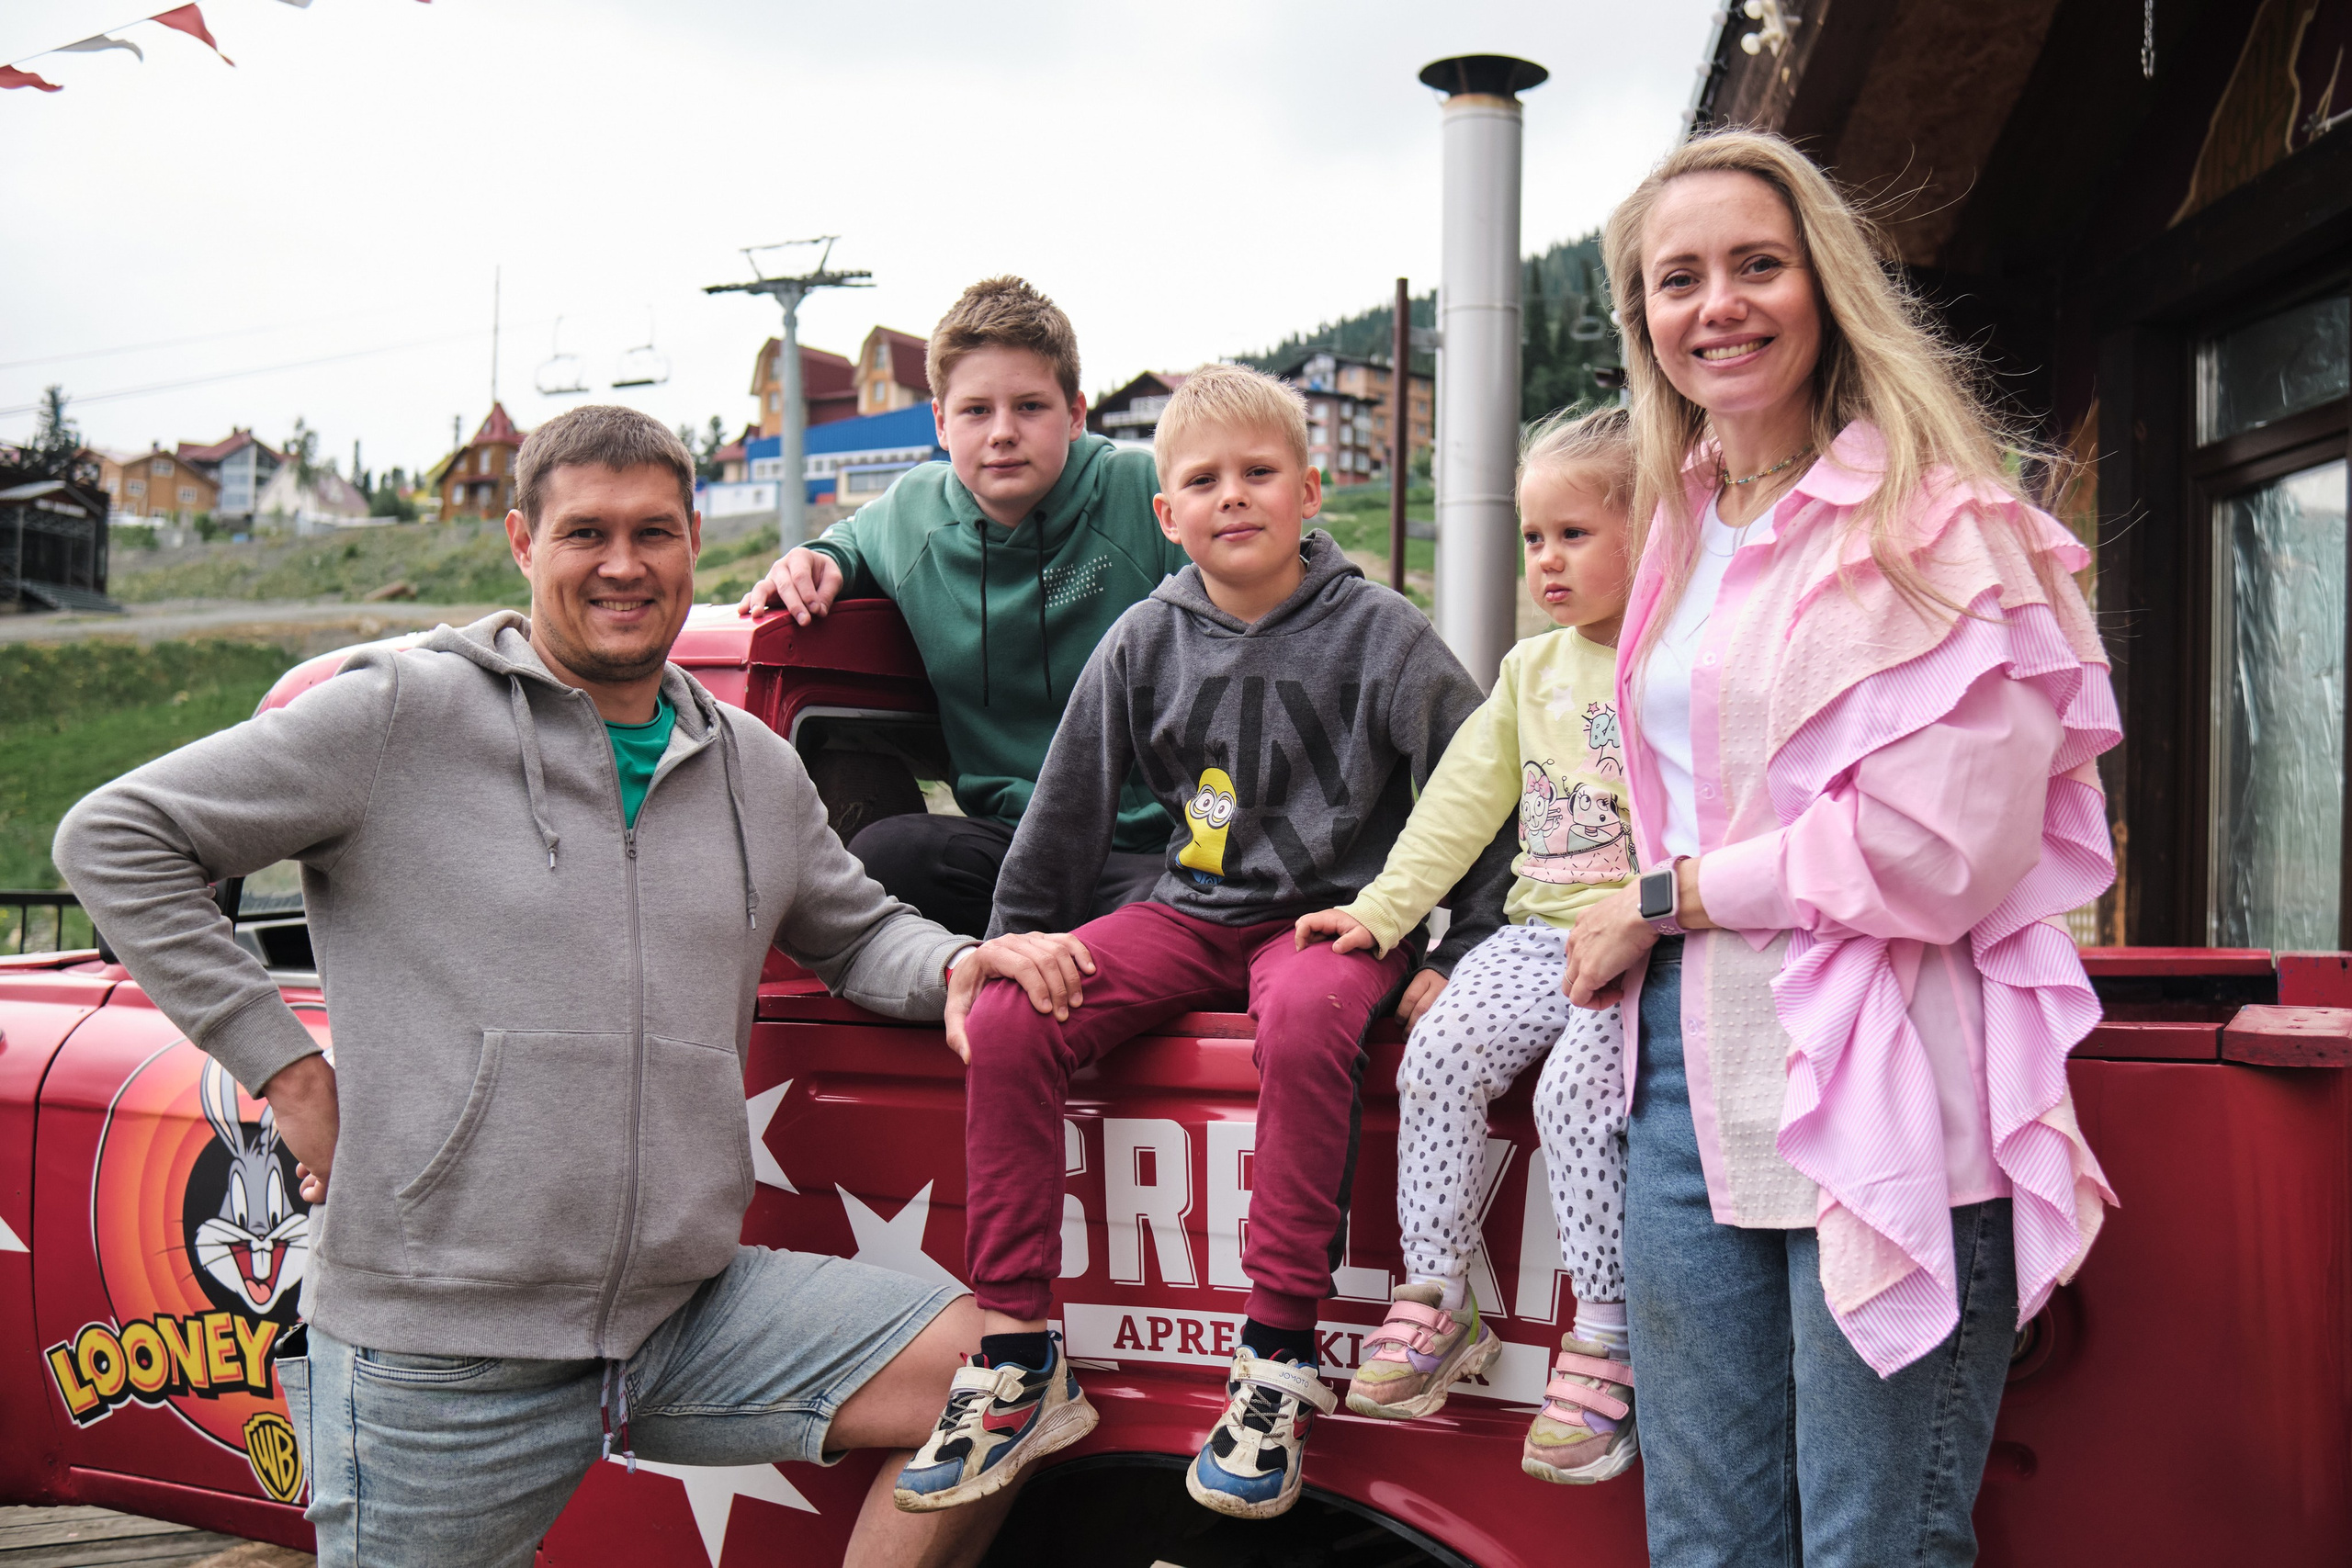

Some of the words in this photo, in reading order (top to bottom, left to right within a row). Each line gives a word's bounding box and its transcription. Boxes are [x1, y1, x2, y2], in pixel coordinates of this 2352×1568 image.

[1088, 554, 1108, 566] LOSE
[1092, 561, 1113, 572] CORE
[1046, 574, 1095, 594] NTELLIGENT
[1048, 581, 1096, 601] ENERATION
[1113, 1314, 1245, 1358] APRE
[1317, 1330, 1364, 1370] KI
[47, 1311, 280, 1418] LOONEY
[252, 1424, 295, 1494] WB
